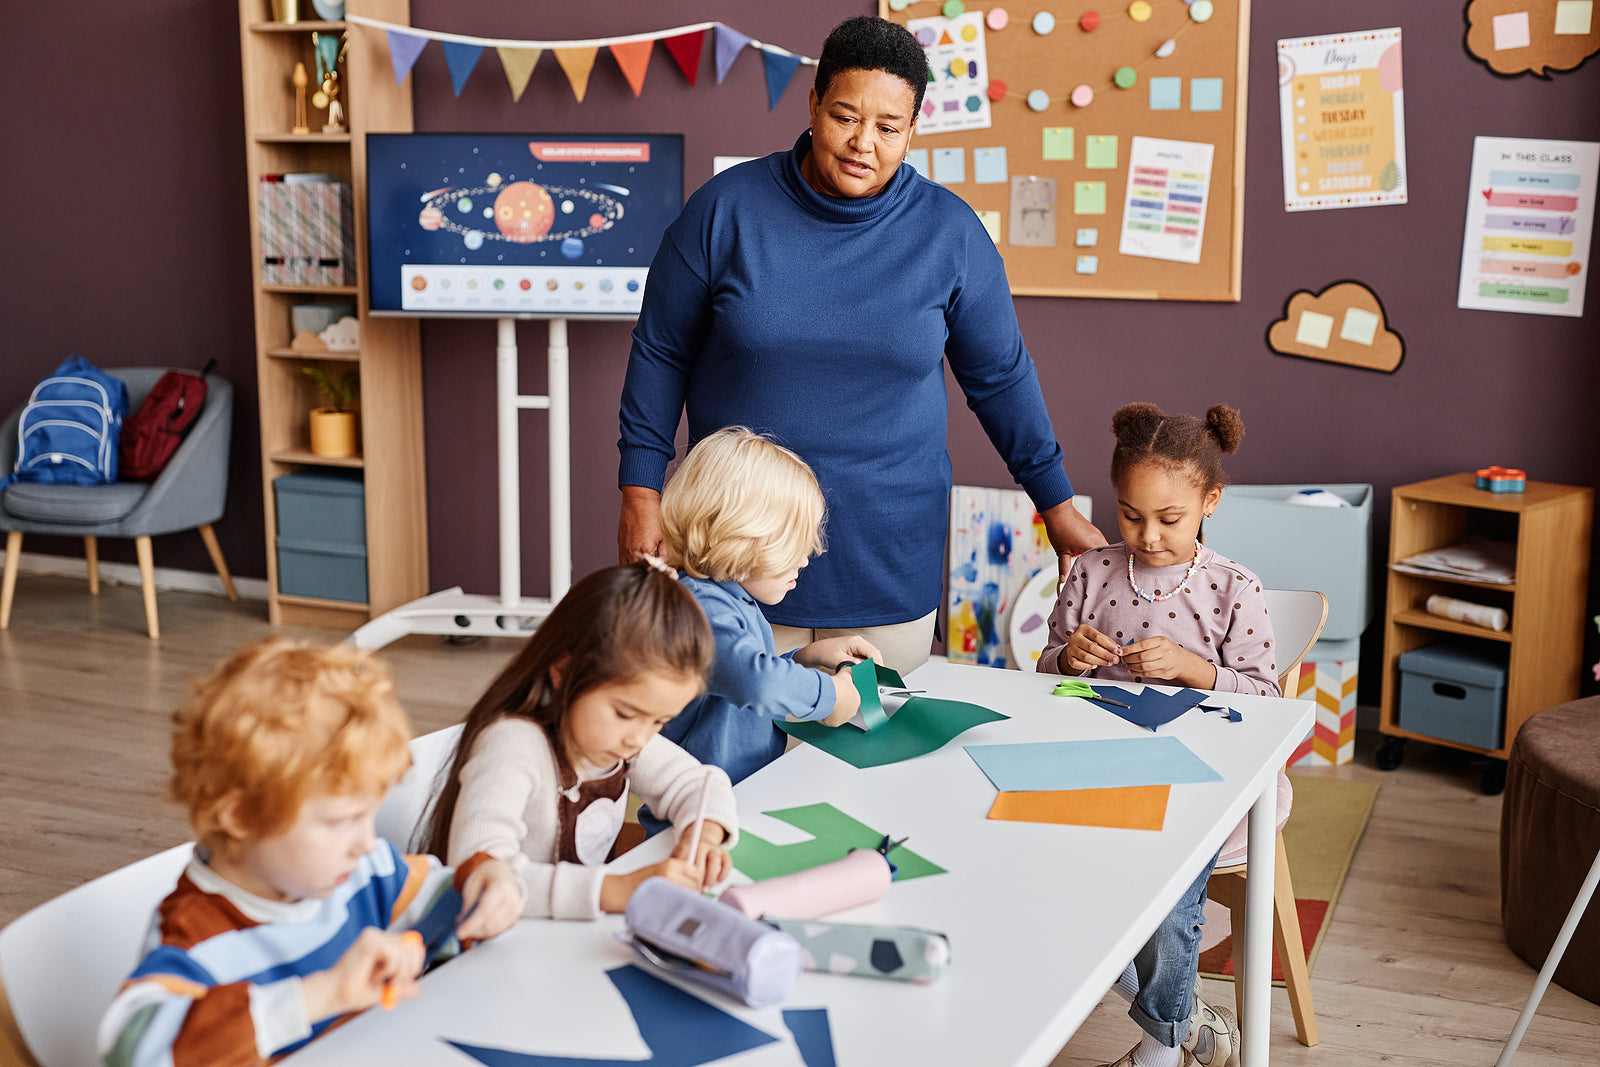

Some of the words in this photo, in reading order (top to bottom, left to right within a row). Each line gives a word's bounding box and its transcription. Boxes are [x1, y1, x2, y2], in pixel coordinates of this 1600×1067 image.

[1323, 49, 1358, 70] Days
[1319, 74, 1361, 91] SUNDAY
[1320, 91, 1365, 106] MONDAY
[1321, 109, 1366, 124] TUESDAY
[1313, 126, 1375, 142] WEDNESDAY
[1319, 144, 1371, 159] THURSDAY
[1501, 152, 1512, 160] IN
[1515, 152, 1537, 161] THIS
[1540, 153, 1573, 163] CLASS
[1326, 160, 1364, 174] FRIDAY
[1318, 174, 1373, 192] SATURDAY
